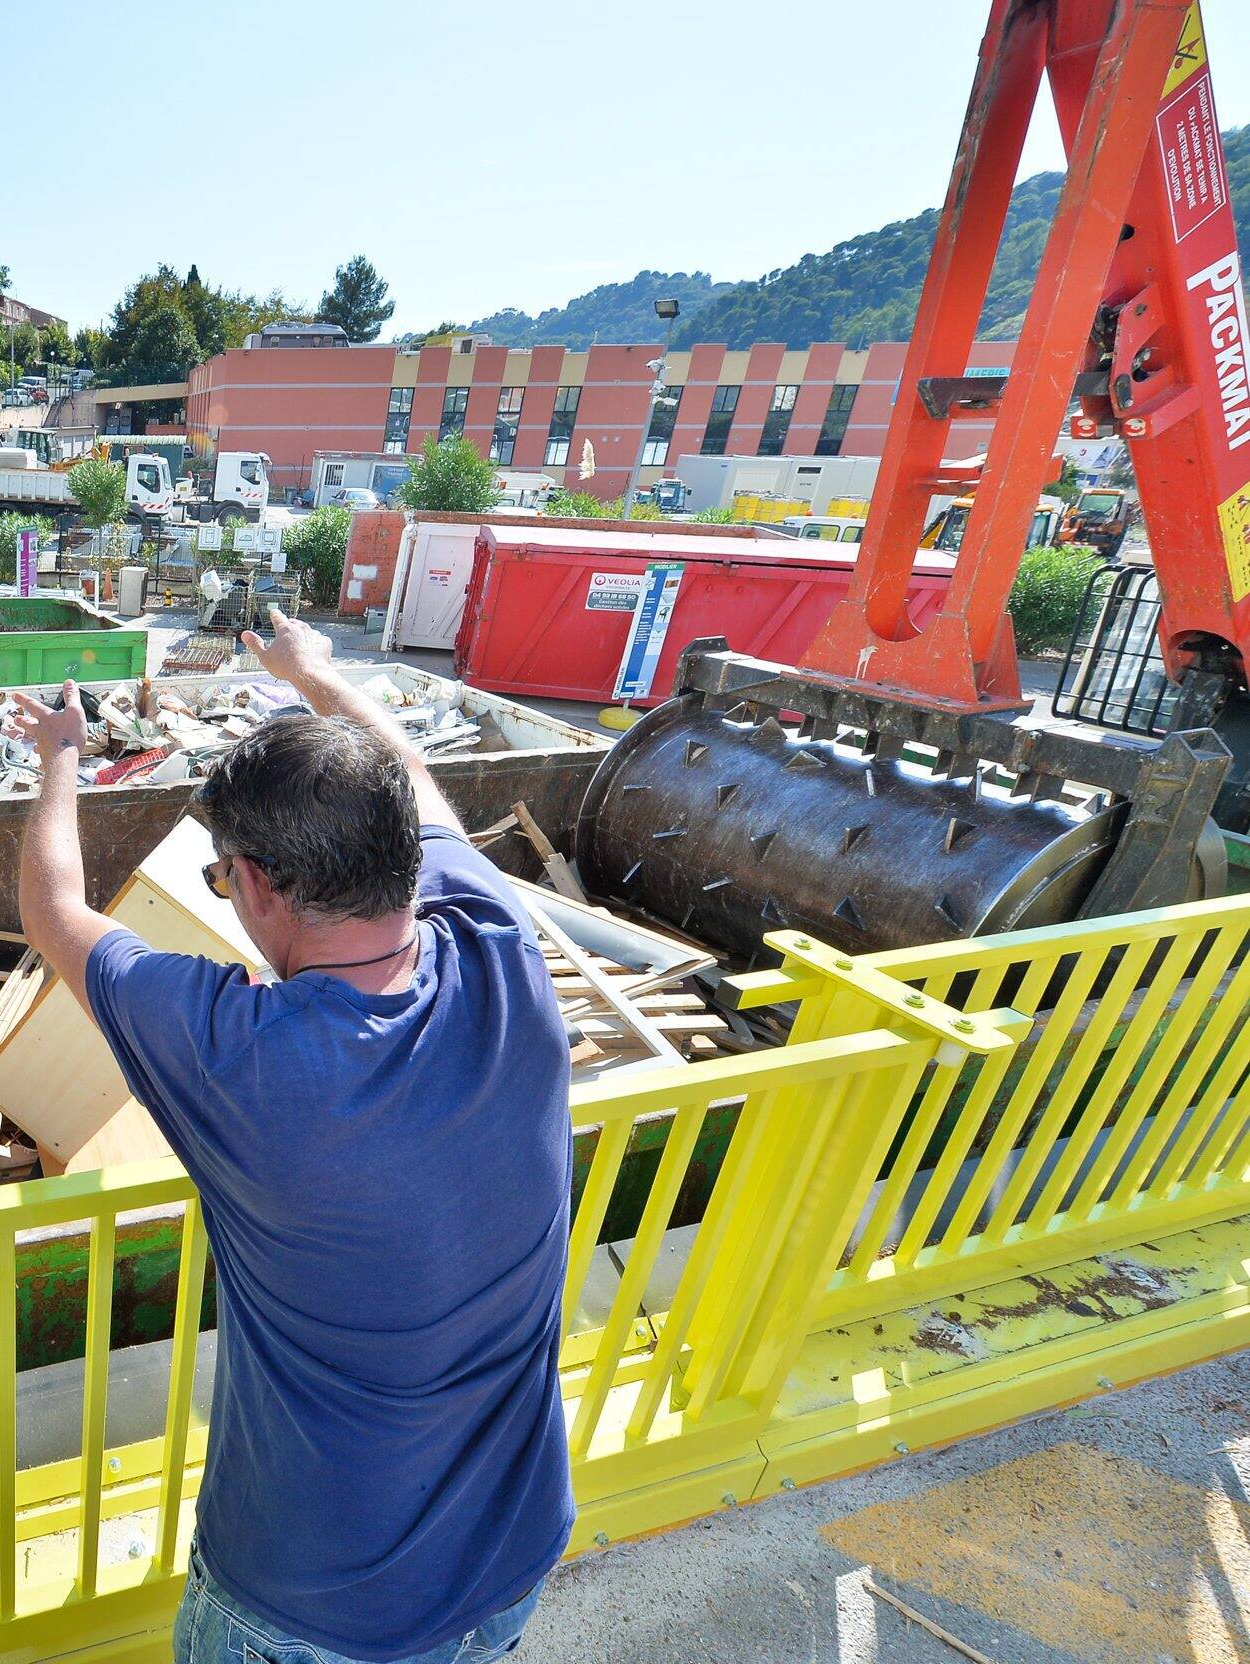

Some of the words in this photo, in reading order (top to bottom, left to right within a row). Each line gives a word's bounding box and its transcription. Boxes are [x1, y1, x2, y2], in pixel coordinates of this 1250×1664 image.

[1198, 81, 1210, 122] PENDANT
[1188, 106, 1196, 120] DU
[1203, 122, 1212, 134] LE
[1183, 160, 1191, 174] DE
[1196, 158, 1204, 172] SE
[1204, 133, 1222, 207] FONCTIONNEMENT
[1184, 174, 1192, 188] SA
[1198, 170, 1208, 196] TENIR
[1186, 184, 1197, 210] ZONE
